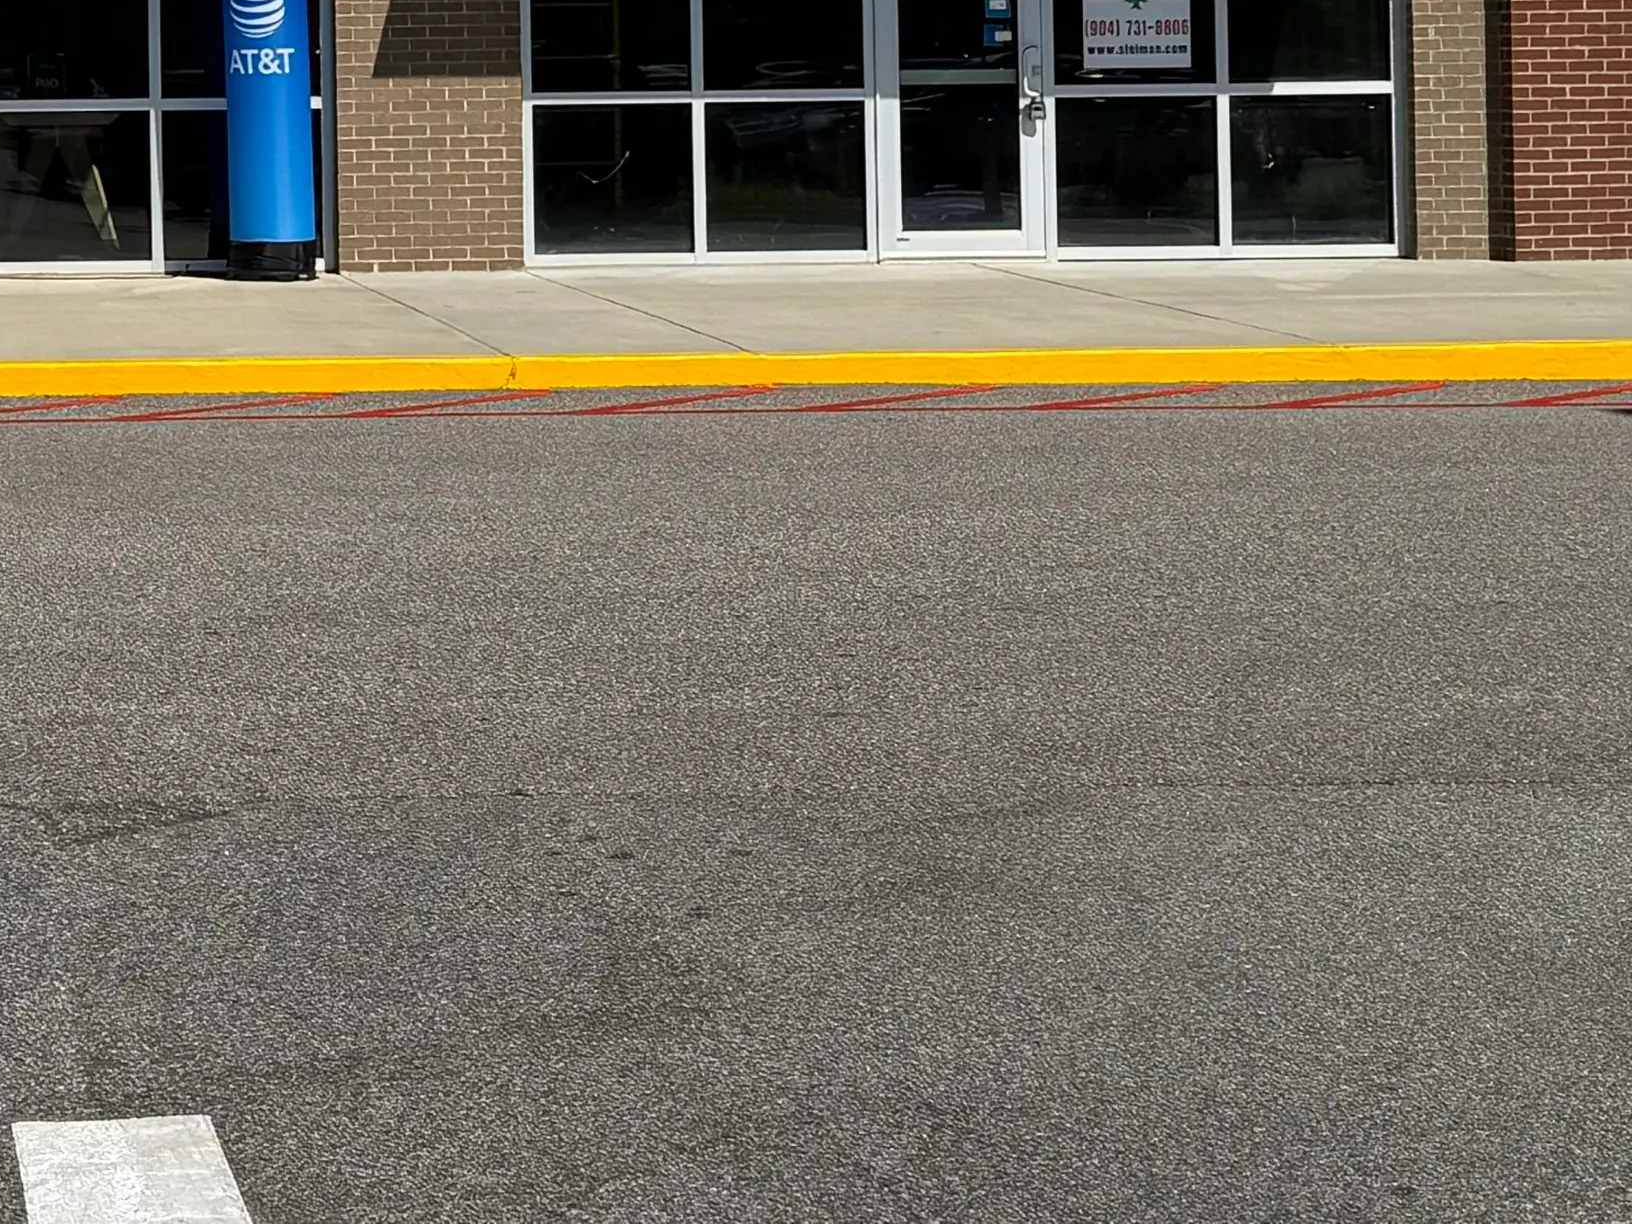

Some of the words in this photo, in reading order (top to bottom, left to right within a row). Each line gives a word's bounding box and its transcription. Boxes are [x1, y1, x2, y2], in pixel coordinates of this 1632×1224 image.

[1085, 19, 1121, 37] (904)
[1125, 19, 1189, 37] 731-8806
[230, 48, 295, 75] AT&T
